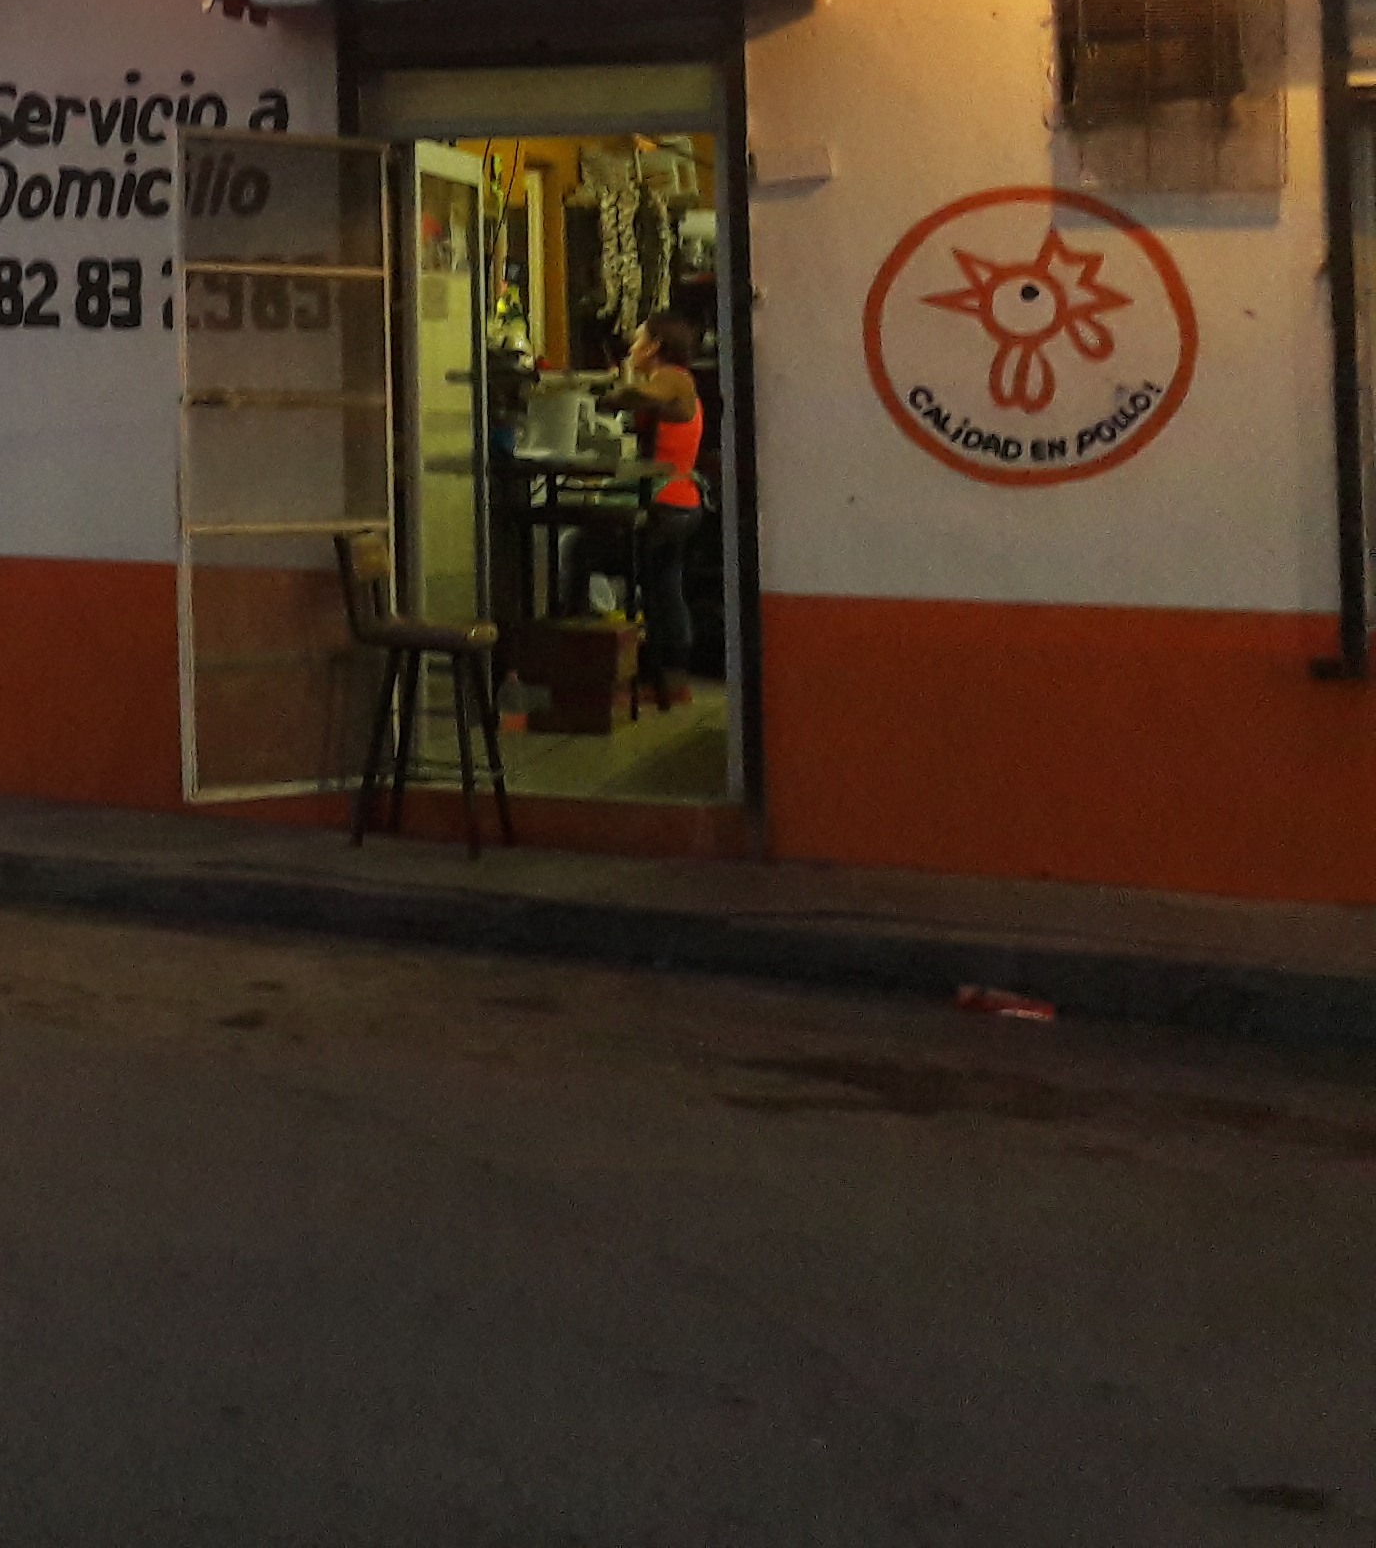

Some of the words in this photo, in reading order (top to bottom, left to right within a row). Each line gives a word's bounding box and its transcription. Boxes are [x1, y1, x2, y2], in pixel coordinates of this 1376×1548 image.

[249, 87, 289, 136] a
[75, 257, 143, 330] 83
[1030, 437, 1067, 462] EN
